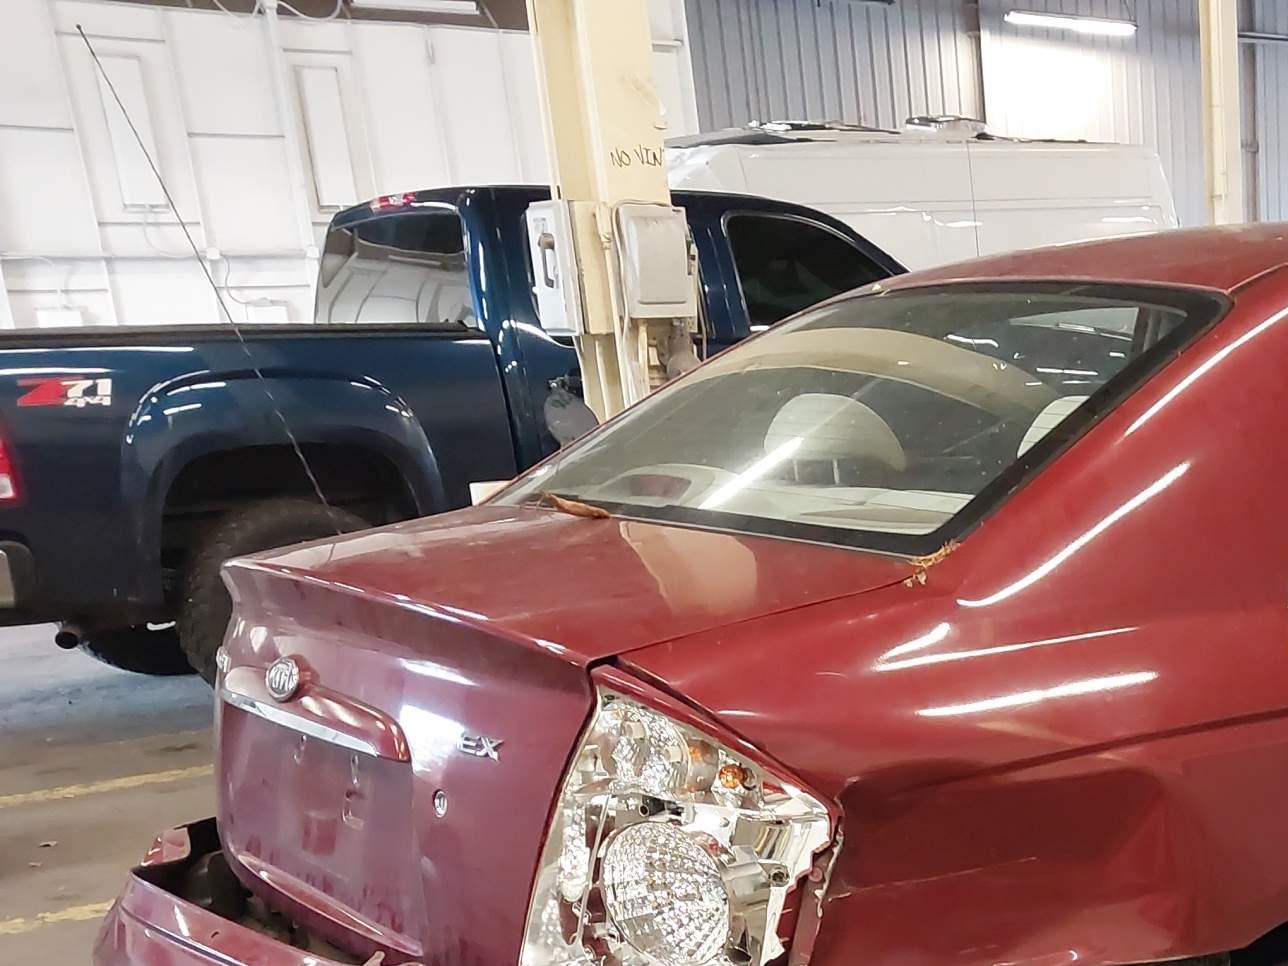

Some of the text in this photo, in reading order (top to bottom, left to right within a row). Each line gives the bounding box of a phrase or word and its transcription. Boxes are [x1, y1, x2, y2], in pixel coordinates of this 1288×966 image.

[610, 147, 631, 168] NO
[16, 377, 112, 406] Z71
[457, 735, 504, 761] EX
